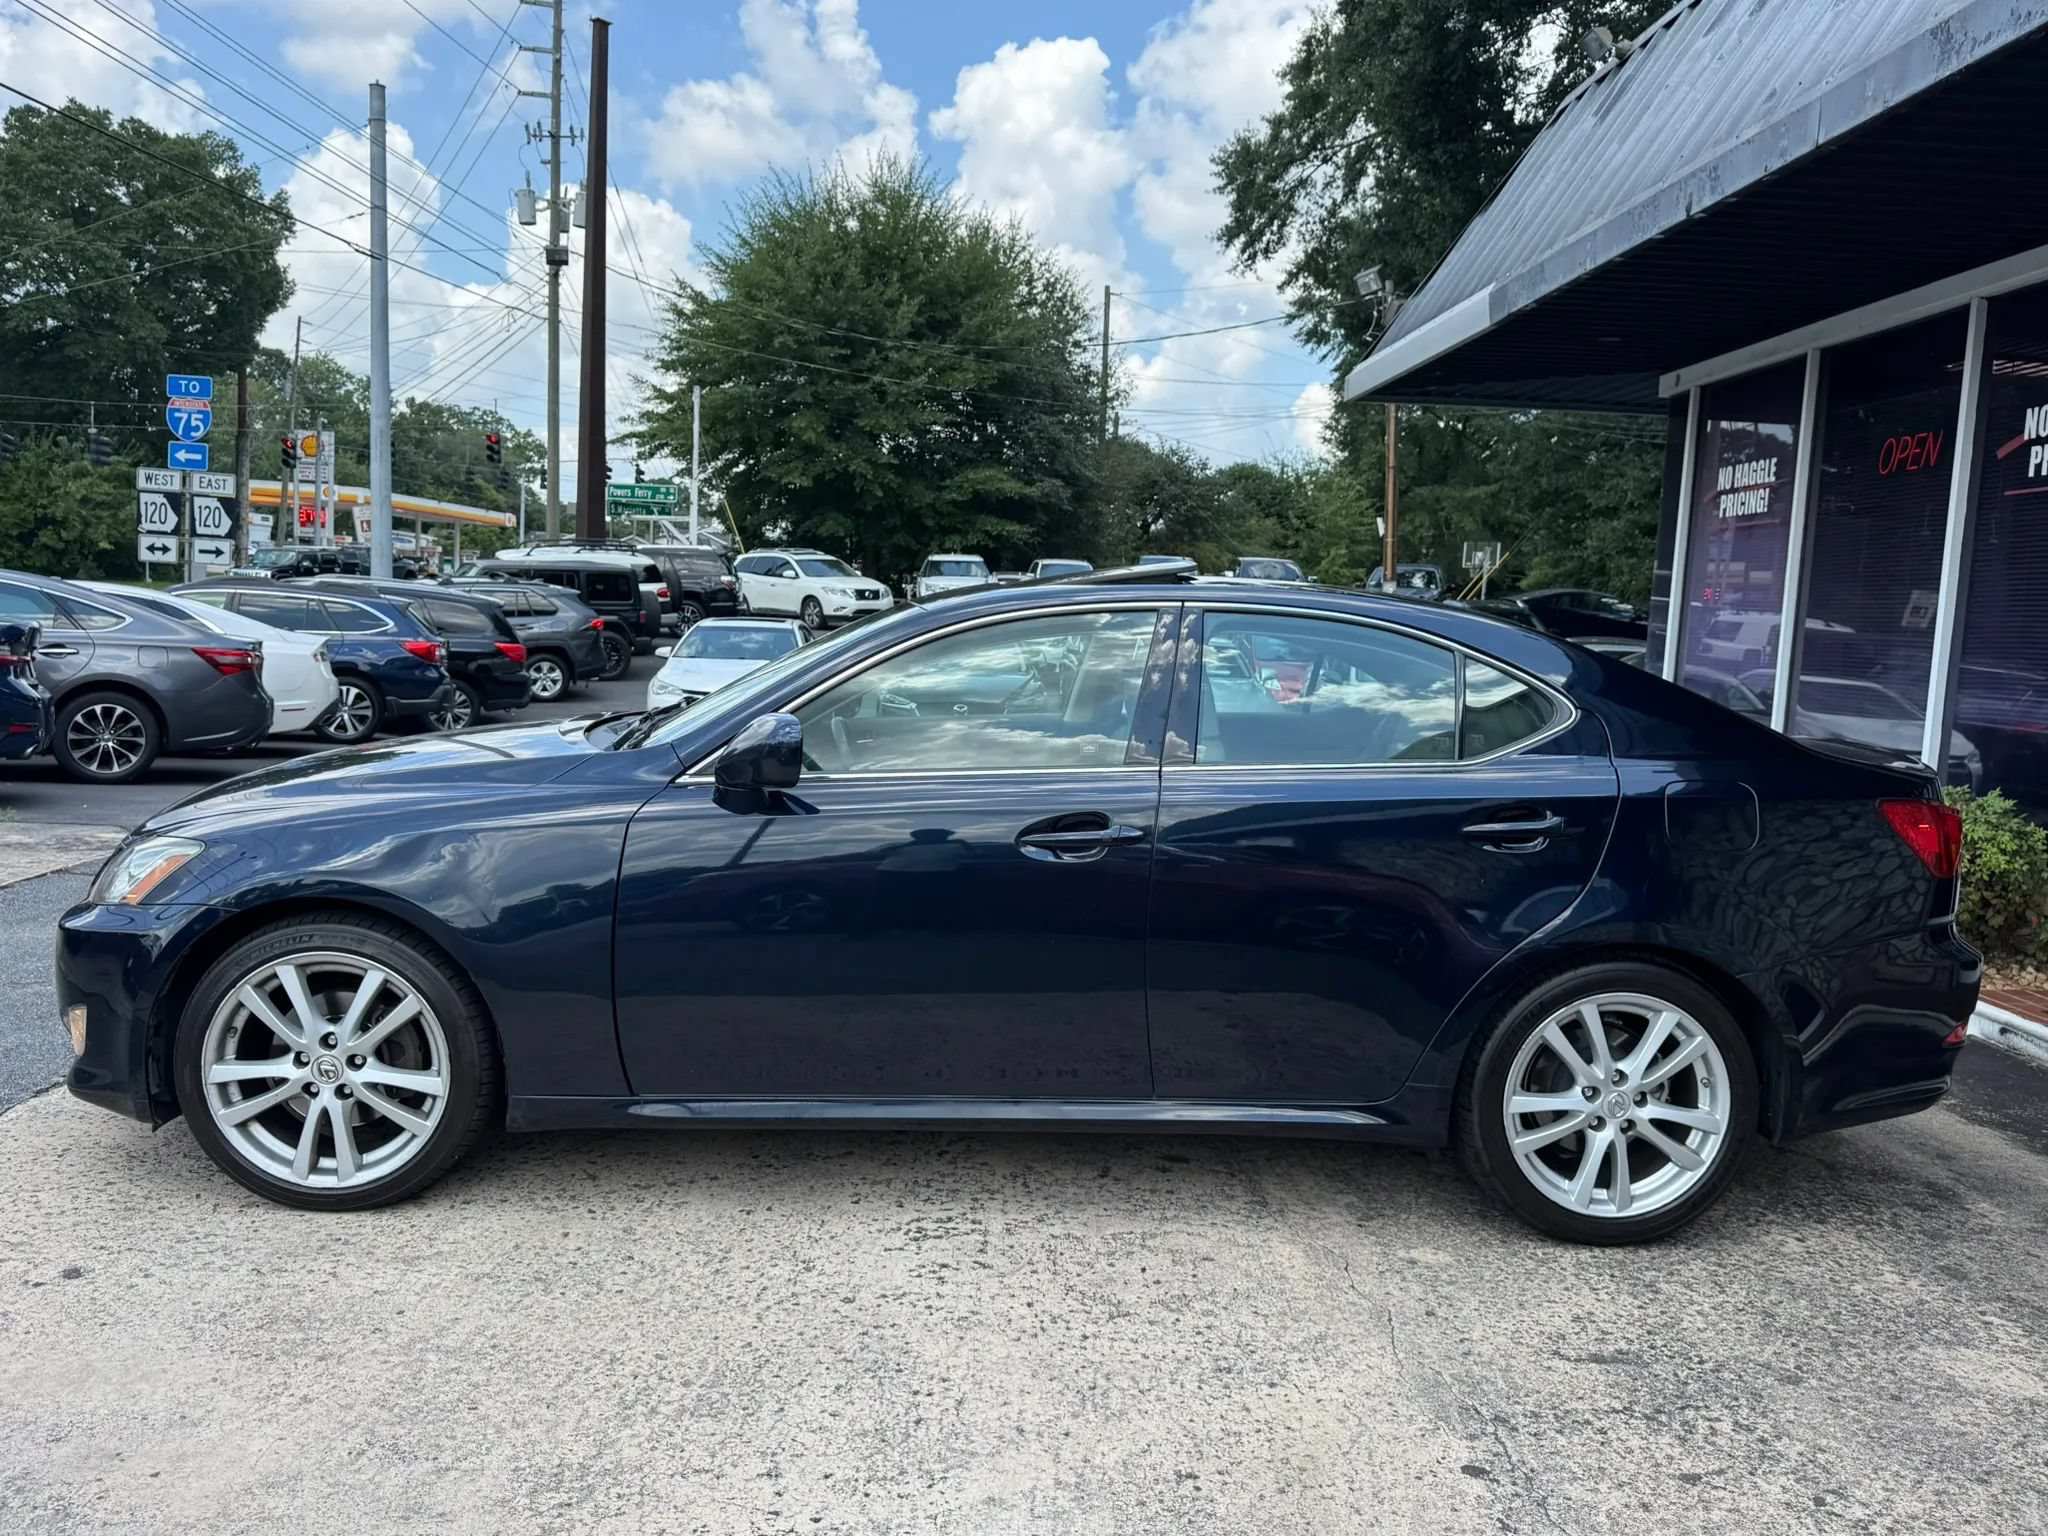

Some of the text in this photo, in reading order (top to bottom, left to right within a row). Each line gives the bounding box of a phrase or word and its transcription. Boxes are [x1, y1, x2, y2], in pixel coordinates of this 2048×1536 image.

[178, 380, 200, 393] TO
[174, 412, 205, 437] 75
[1879, 430, 1944, 475] OPEN
[144, 472, 176, 486] WEST
[199, 476, 228, 491] EAST
[1717, 457, 1778, 492] NO HAGGLE
[609, 486, 632, 497] Powers
[634, 487, 653, 500] Ferry
[1719, 487, 1770, 518] PRICING!
[144, 501, 168, 525] 120
[198, 505, 222, 529] 120
